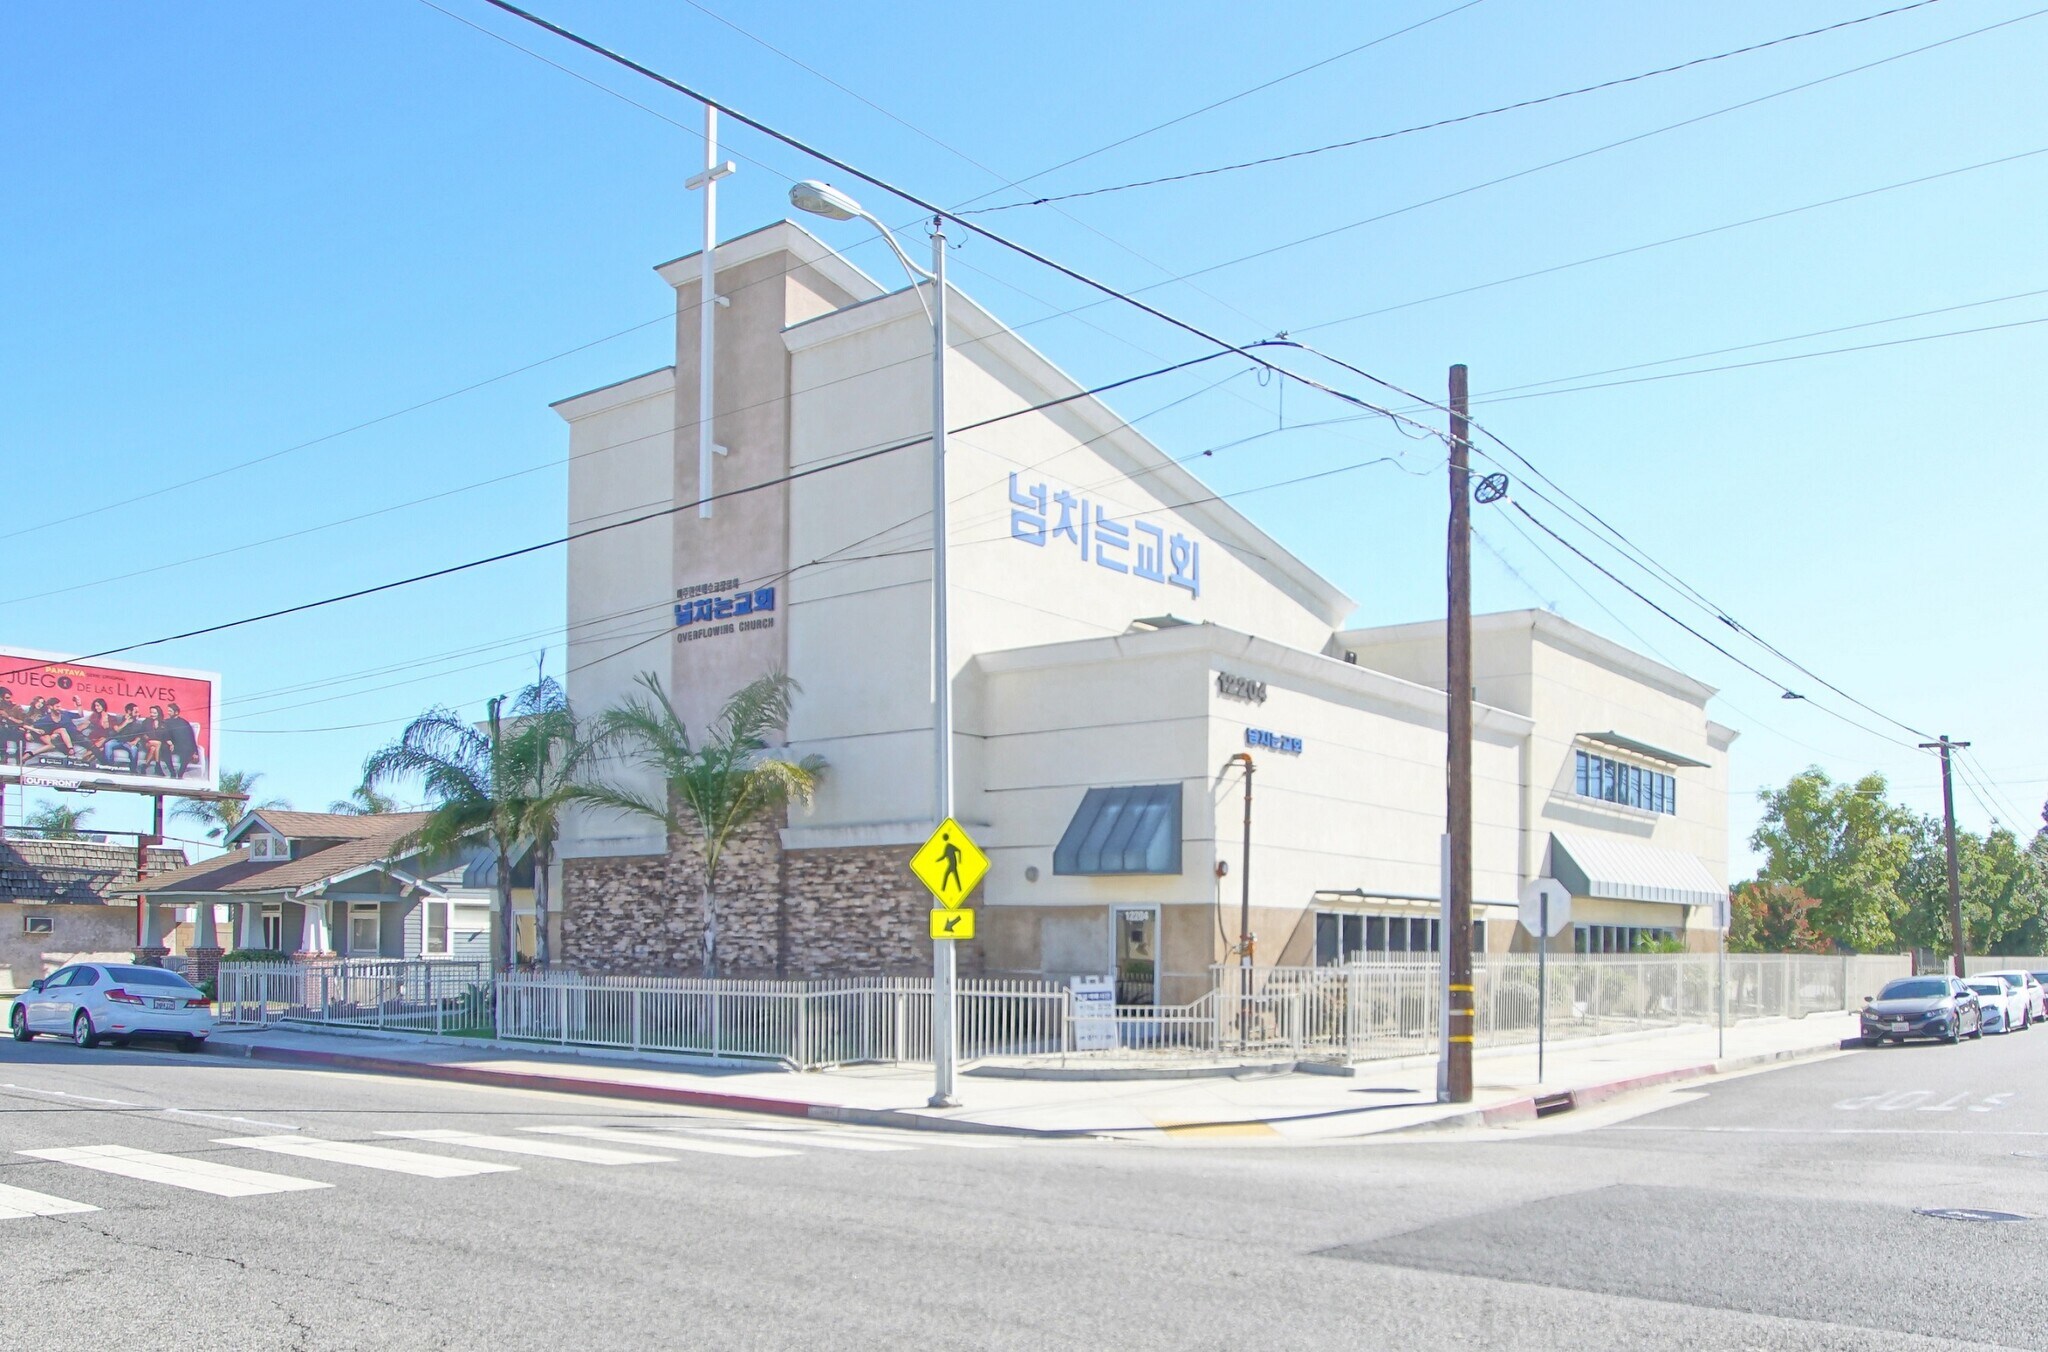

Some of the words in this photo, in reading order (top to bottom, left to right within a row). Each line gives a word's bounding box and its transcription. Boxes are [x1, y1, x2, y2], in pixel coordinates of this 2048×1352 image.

[1009, 471, 1200, 599] 넘치는교회
[675, 587, 775, 626] 넘치는교회
[677, 624, 735, 643] OVERFLOWING
[739, 617, 774, 632] CHURCH
[45, 666, 85, 677] PANTAYA
[77, 683, 93, 692] DE
[94, 684, 114, 695] LAS
[117, 683, 176, 702] LLAVES
[1217, 671, 1267, 703] 12204
[26, 777, 78, 788] OUTFRONT
